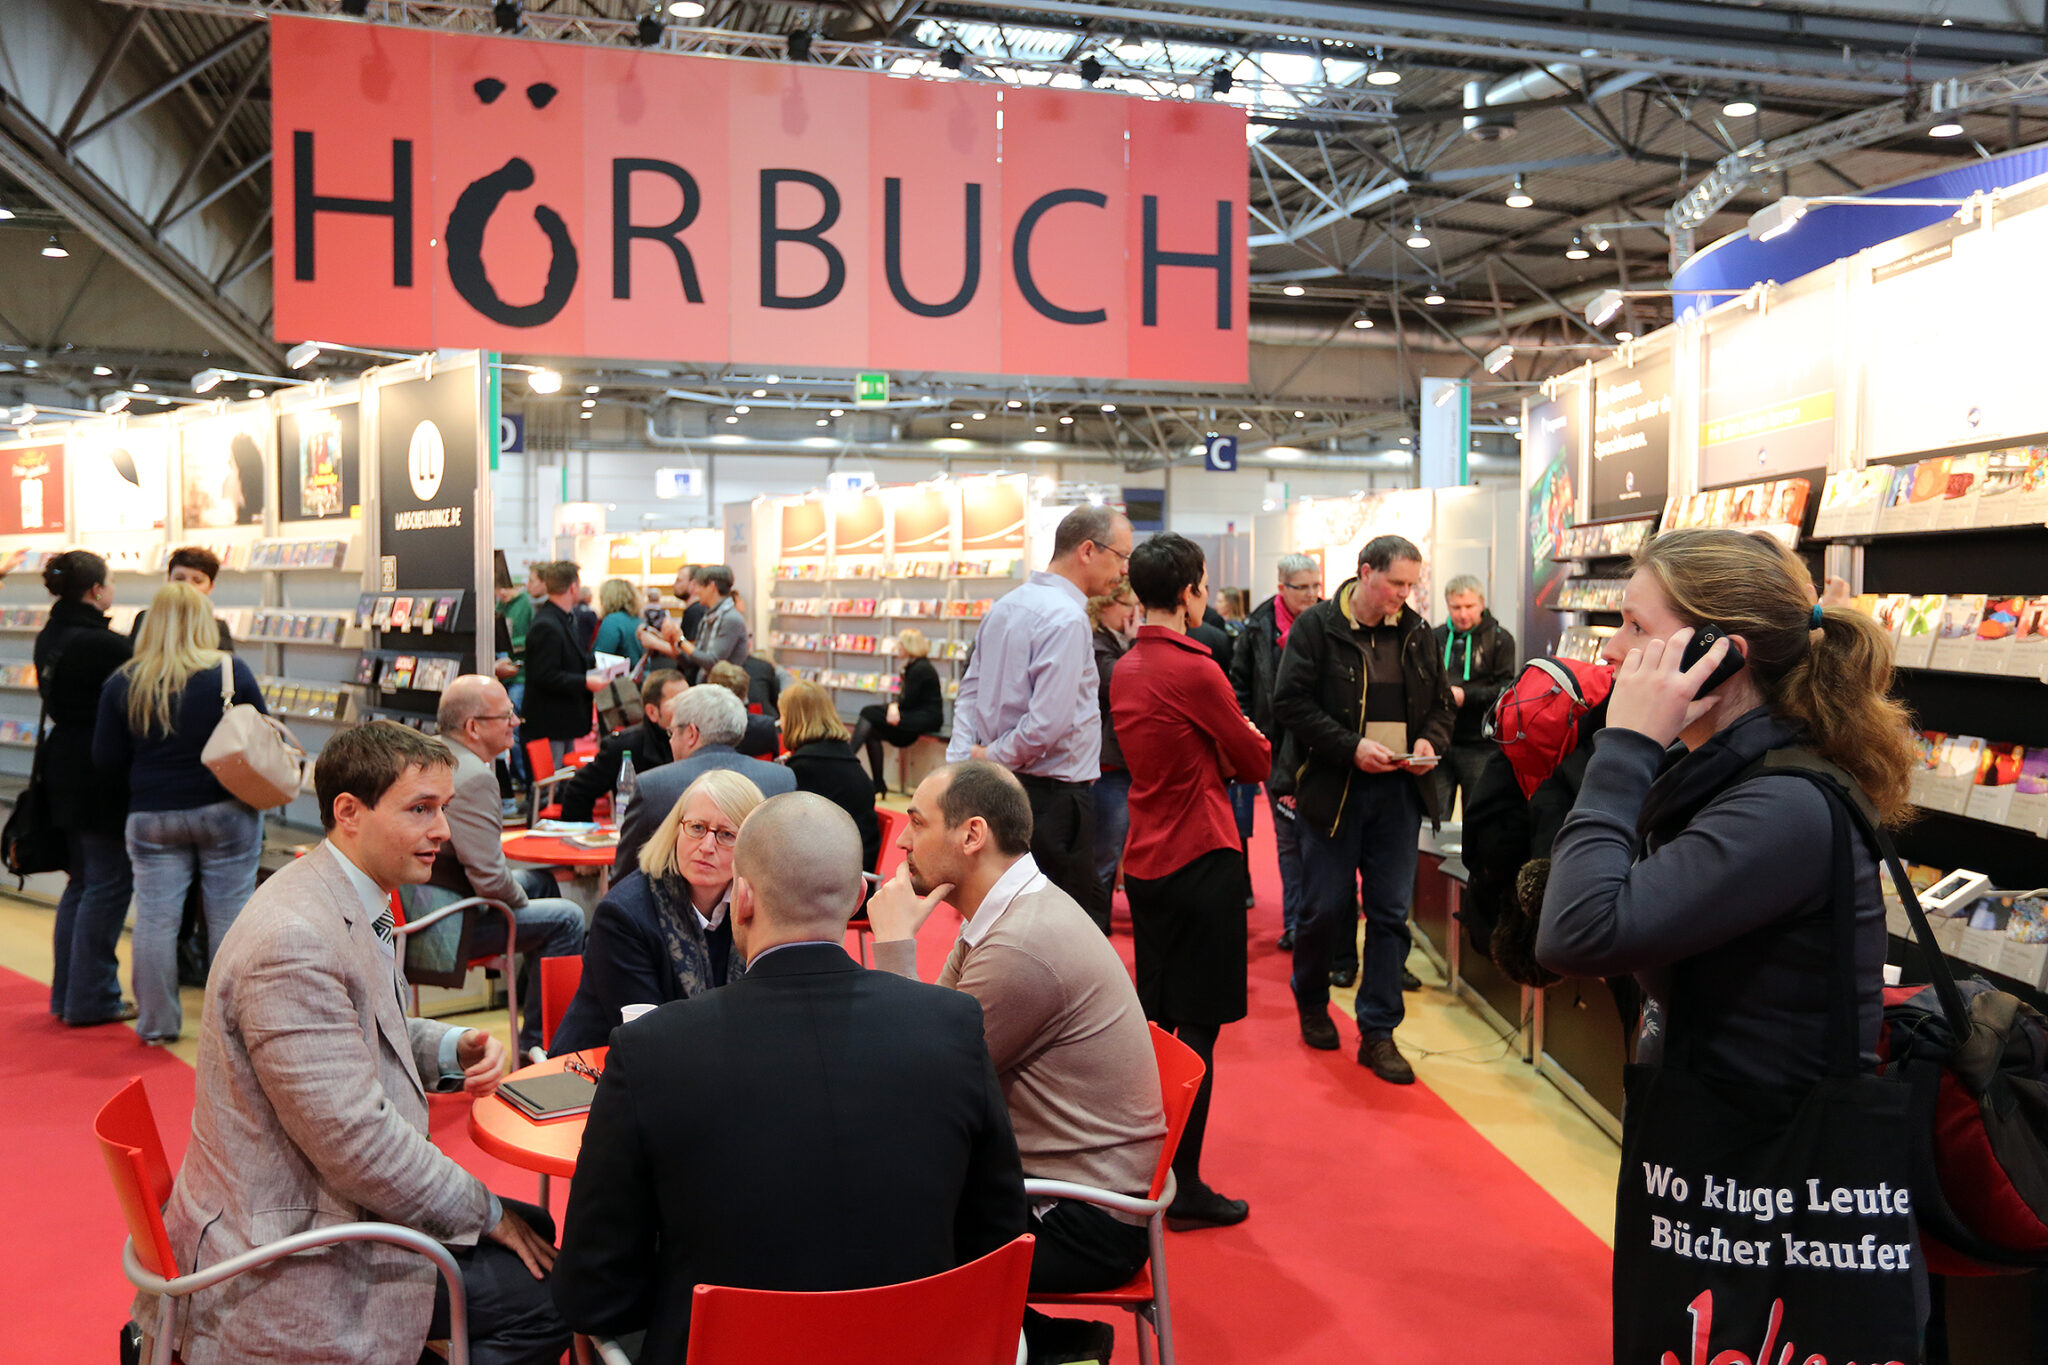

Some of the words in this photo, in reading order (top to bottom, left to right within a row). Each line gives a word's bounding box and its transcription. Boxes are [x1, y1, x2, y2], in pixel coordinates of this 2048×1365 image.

[292, 78, 1234, 330] HÖRBUCH
[1210, 437, 1233, 470] C
[1643, 1161, 1689, 1202] Wo
[1702, 1174, 1794, 1222] kluge
[1806, 1178, 1909, 1215] Leute
[1650, 1213, 1770, 1267] Bücher
